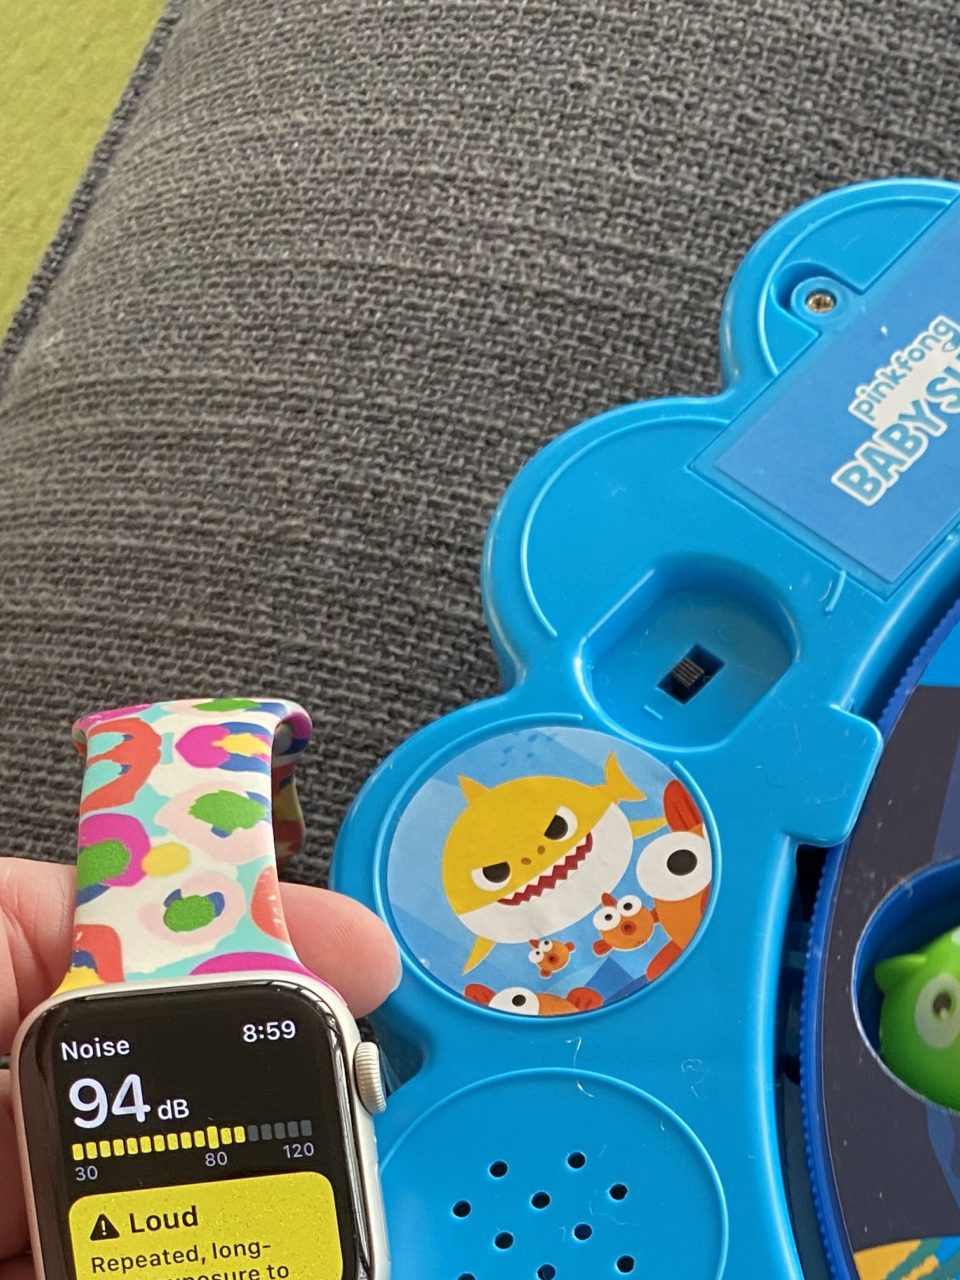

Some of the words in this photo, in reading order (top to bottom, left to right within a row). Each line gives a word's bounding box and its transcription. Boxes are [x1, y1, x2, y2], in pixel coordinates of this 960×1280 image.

[242, 1020, 296, 1043] 8:59
[61, 1037, 131, 1060] Noise
[69, 1073, 151, 1129] 94
[157, 1099, 190, 1120] dB
[75, 1165, 98, 1181] 30
[205, 1151, 228, 1167] 80
[283, 1142, 315, 1159] 120
[129, 1205, 199, 1234] Loud
[91, 1244, 207, 1274] Repeated,
[212, 1239, 271, 1262] long-
[267, 1263, 290, 1280] to
